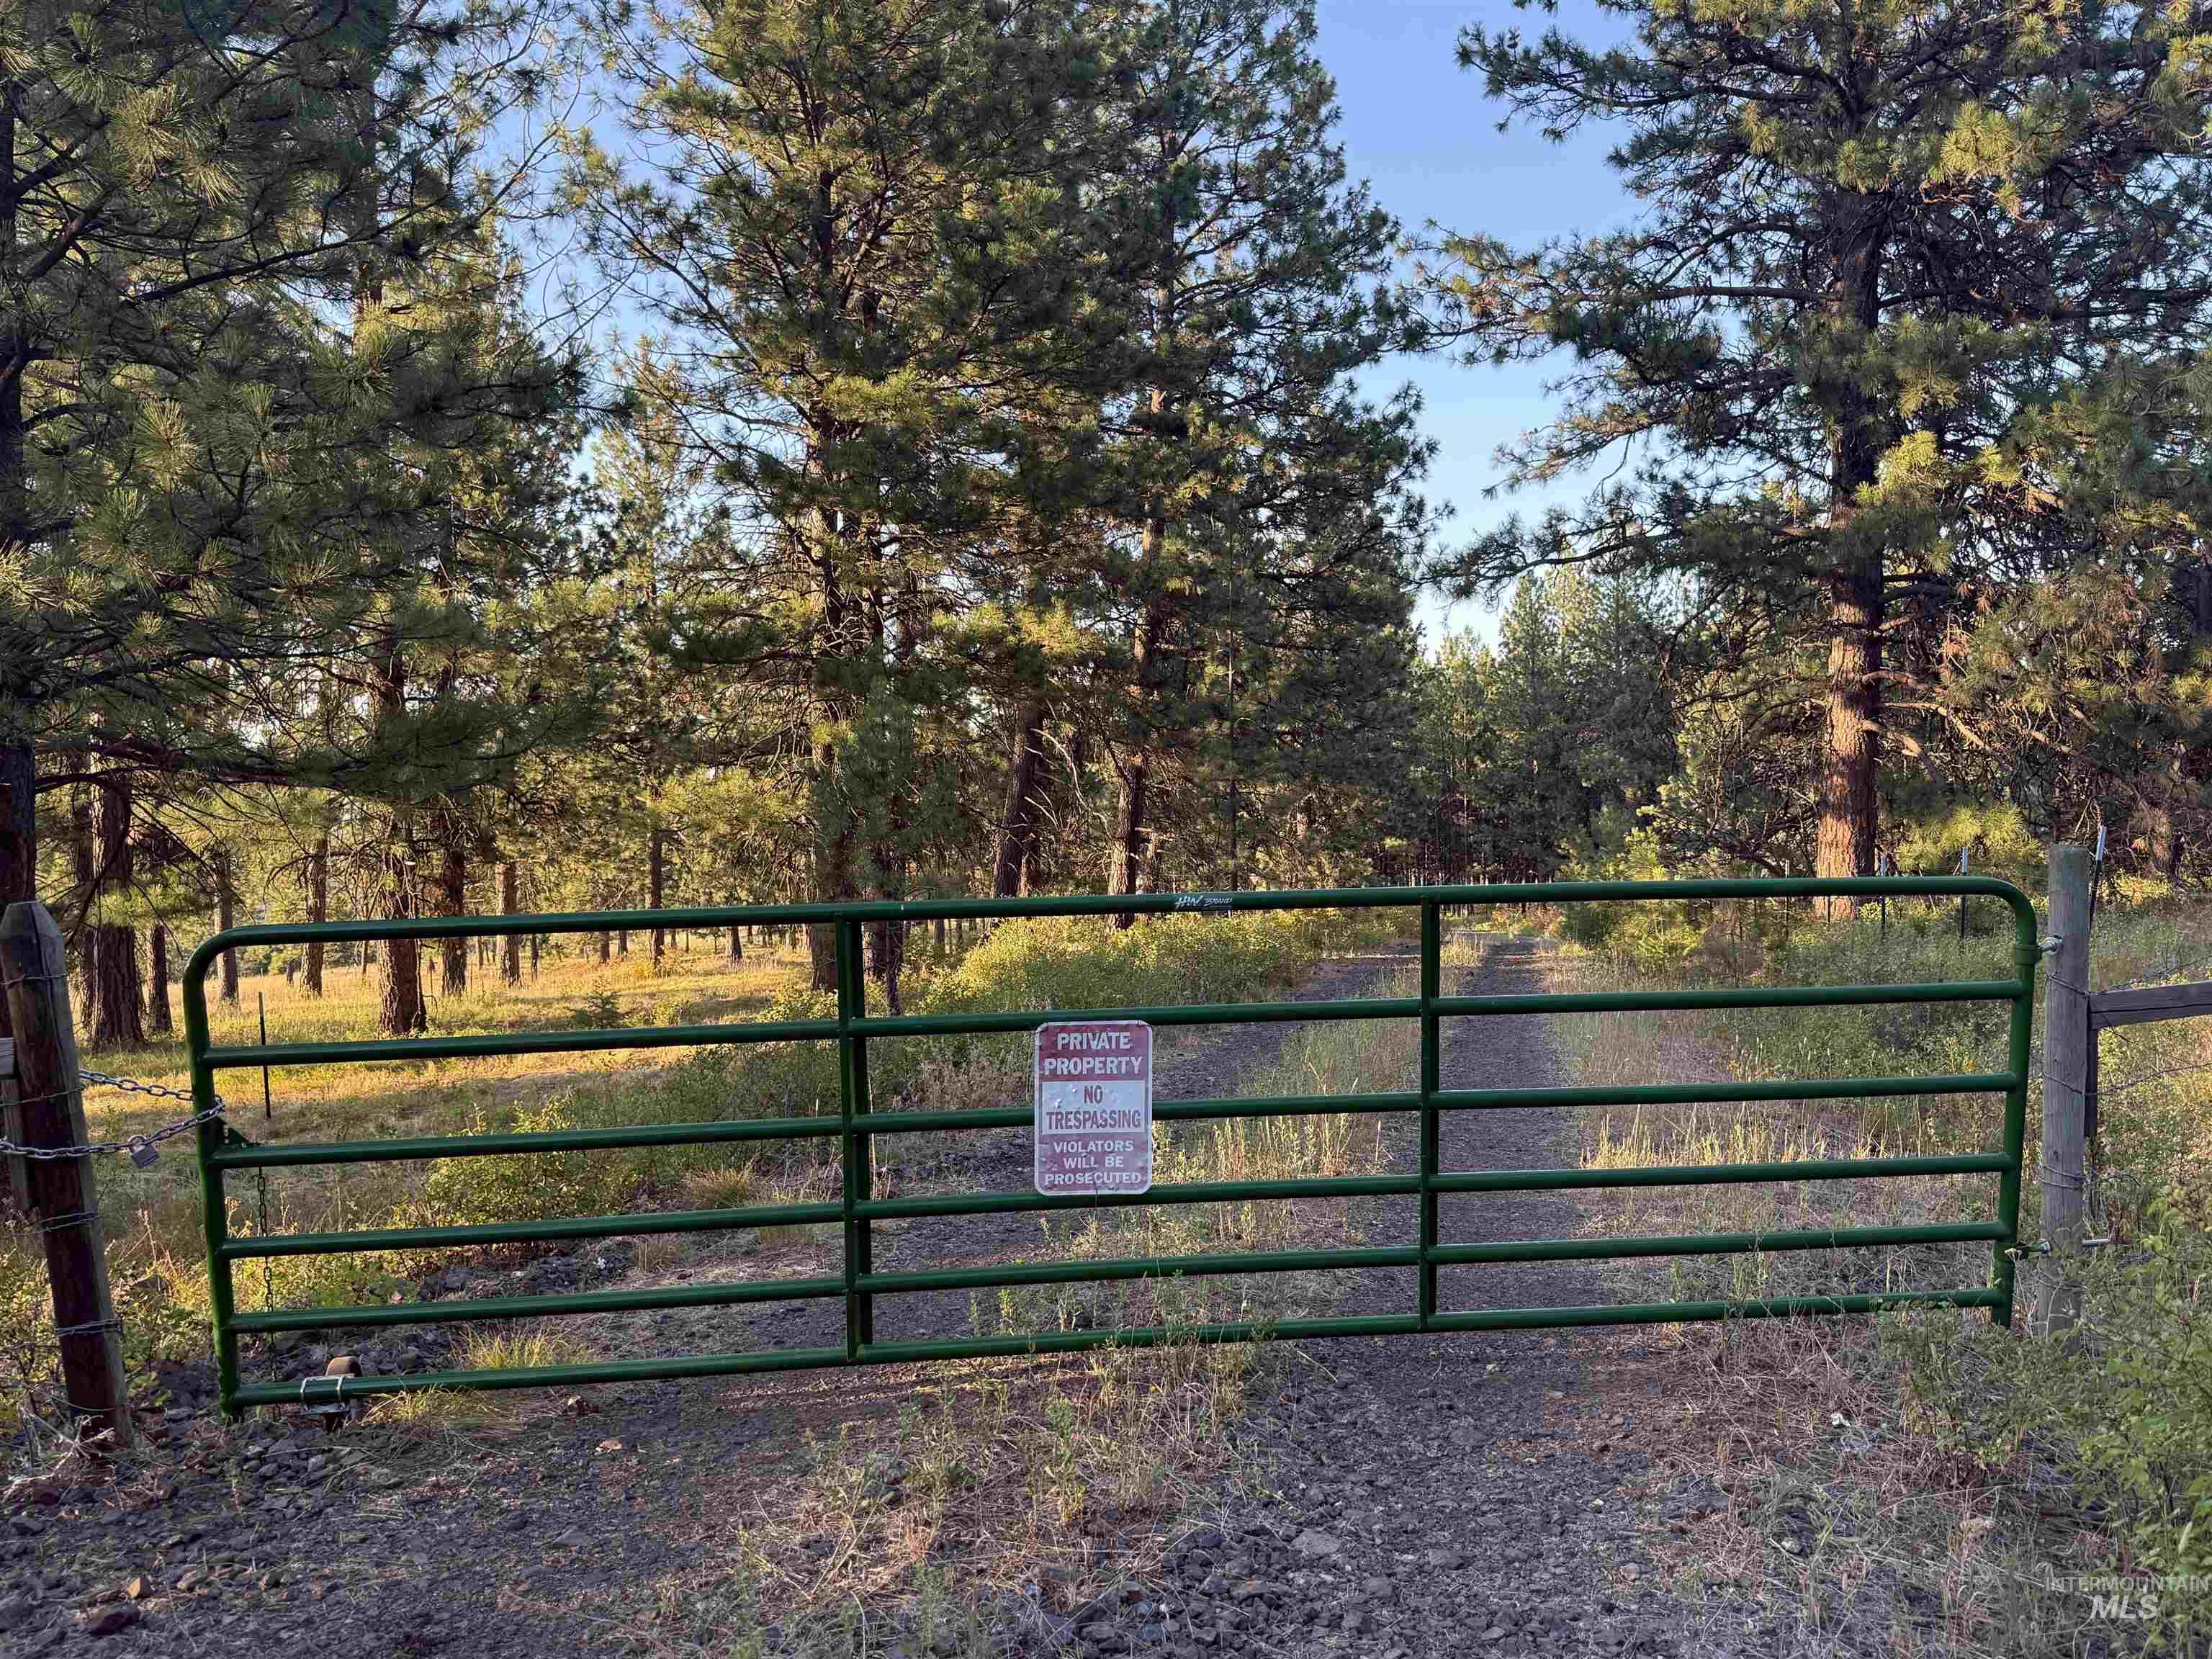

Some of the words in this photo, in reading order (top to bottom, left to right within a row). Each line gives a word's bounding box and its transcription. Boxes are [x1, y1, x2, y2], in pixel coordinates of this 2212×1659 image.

[1057, 1032, 1132, 1050] PRIVATE
[1044, 1056, 1143, 1076] PROPERTY
[1083, 1085, 1104, 1104] NO
[1046, 1110, 1141, 1130] TRESPASSING
[1053, 1140, 1134, 1153] VIOLATORS
[1063, 1156, 1098, 1169] WILL
[1105, 1156, 1124, 1168] BE
[1044, 1172, 1141, 1185] PROSECUTED
